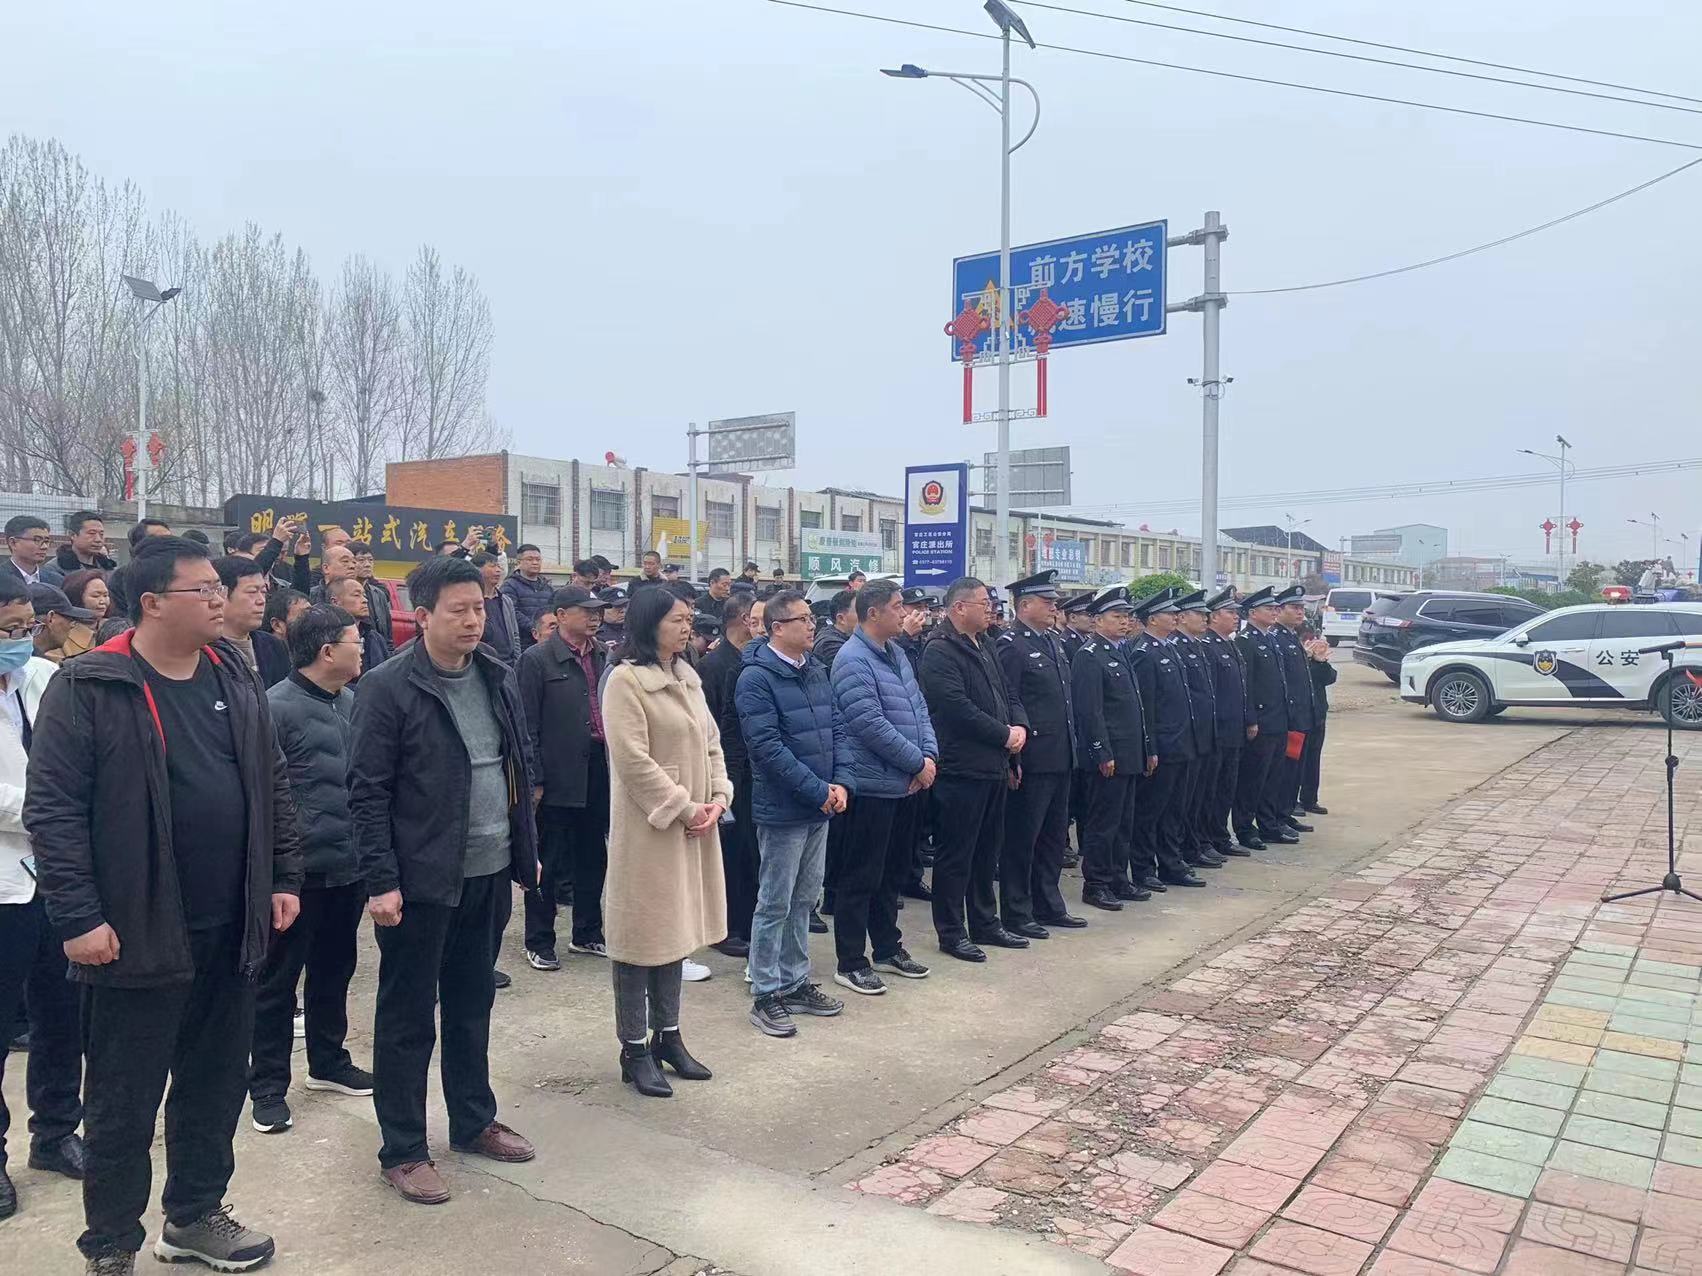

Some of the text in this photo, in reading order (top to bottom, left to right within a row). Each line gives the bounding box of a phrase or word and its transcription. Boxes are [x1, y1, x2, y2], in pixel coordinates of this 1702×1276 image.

[1028, 239, 1154, 288] 前方学校
[1028, 289, 1154, 335] 速慢行
[251, 508, 511, 552] 明一站式汽车务
[912, 540, 953, 549] 官庄派出所
[808, 556, 880, 573] 顺风汽修
[1596, 650, 1640, 666] 公安
